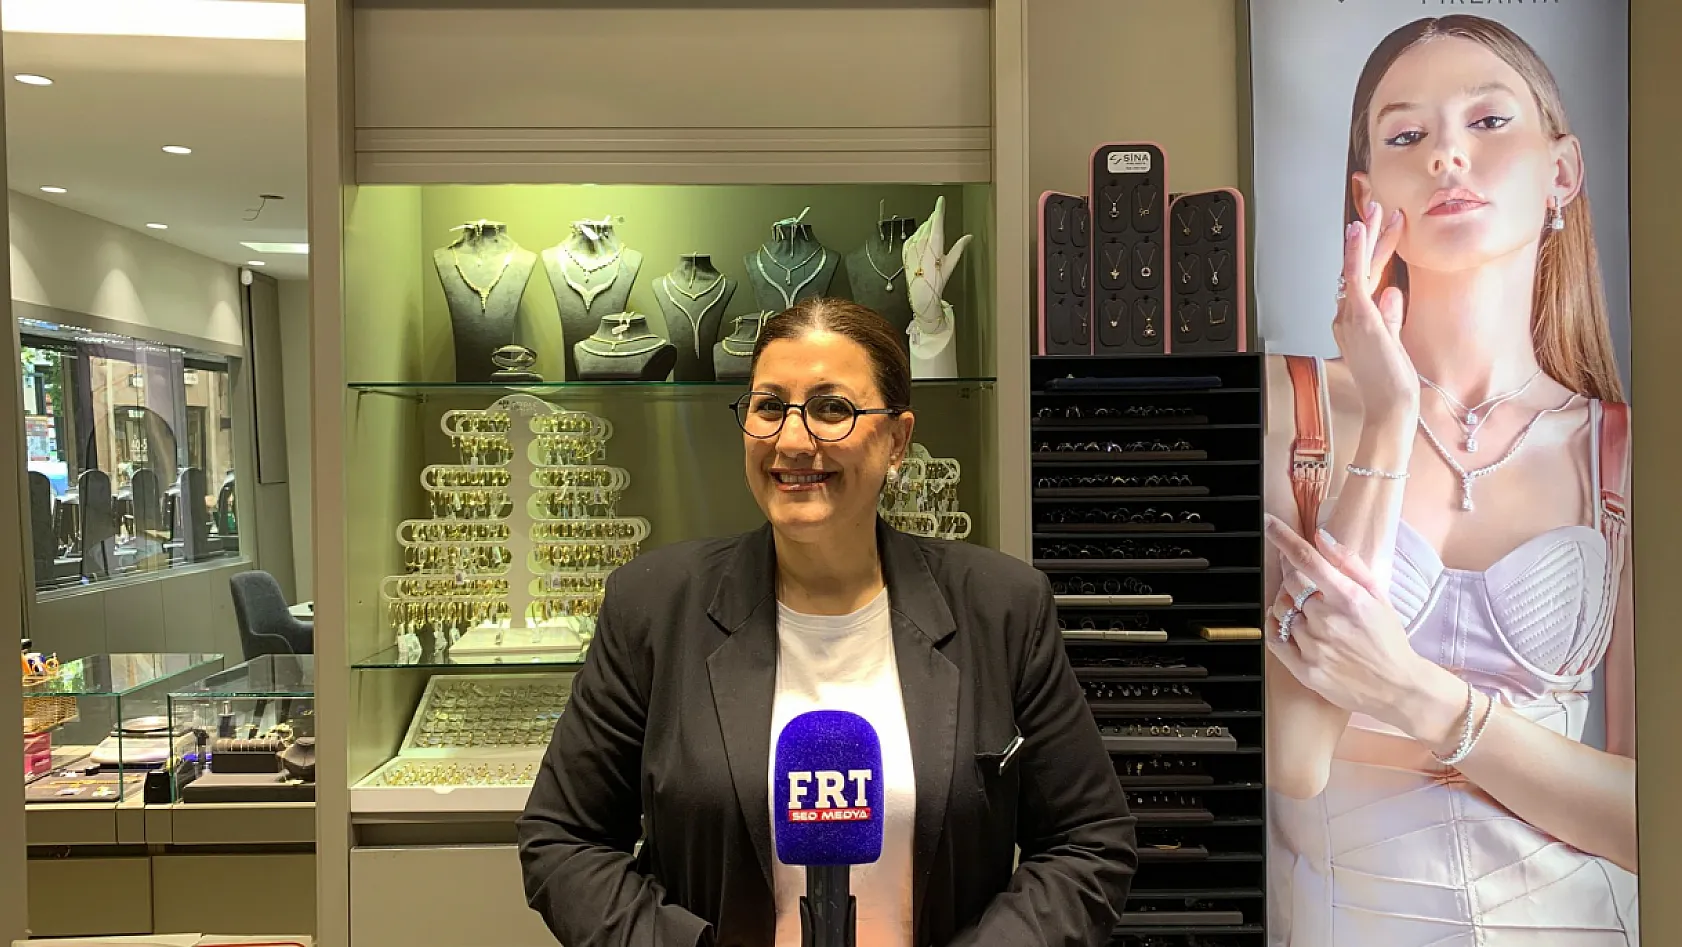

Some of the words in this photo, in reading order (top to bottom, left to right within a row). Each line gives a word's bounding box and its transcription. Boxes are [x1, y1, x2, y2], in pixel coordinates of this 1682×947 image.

[788, 769, 872, 809] FRT
[792, 811, 818, 821] SEO
[821, 809, 868, 820] MEDYA
